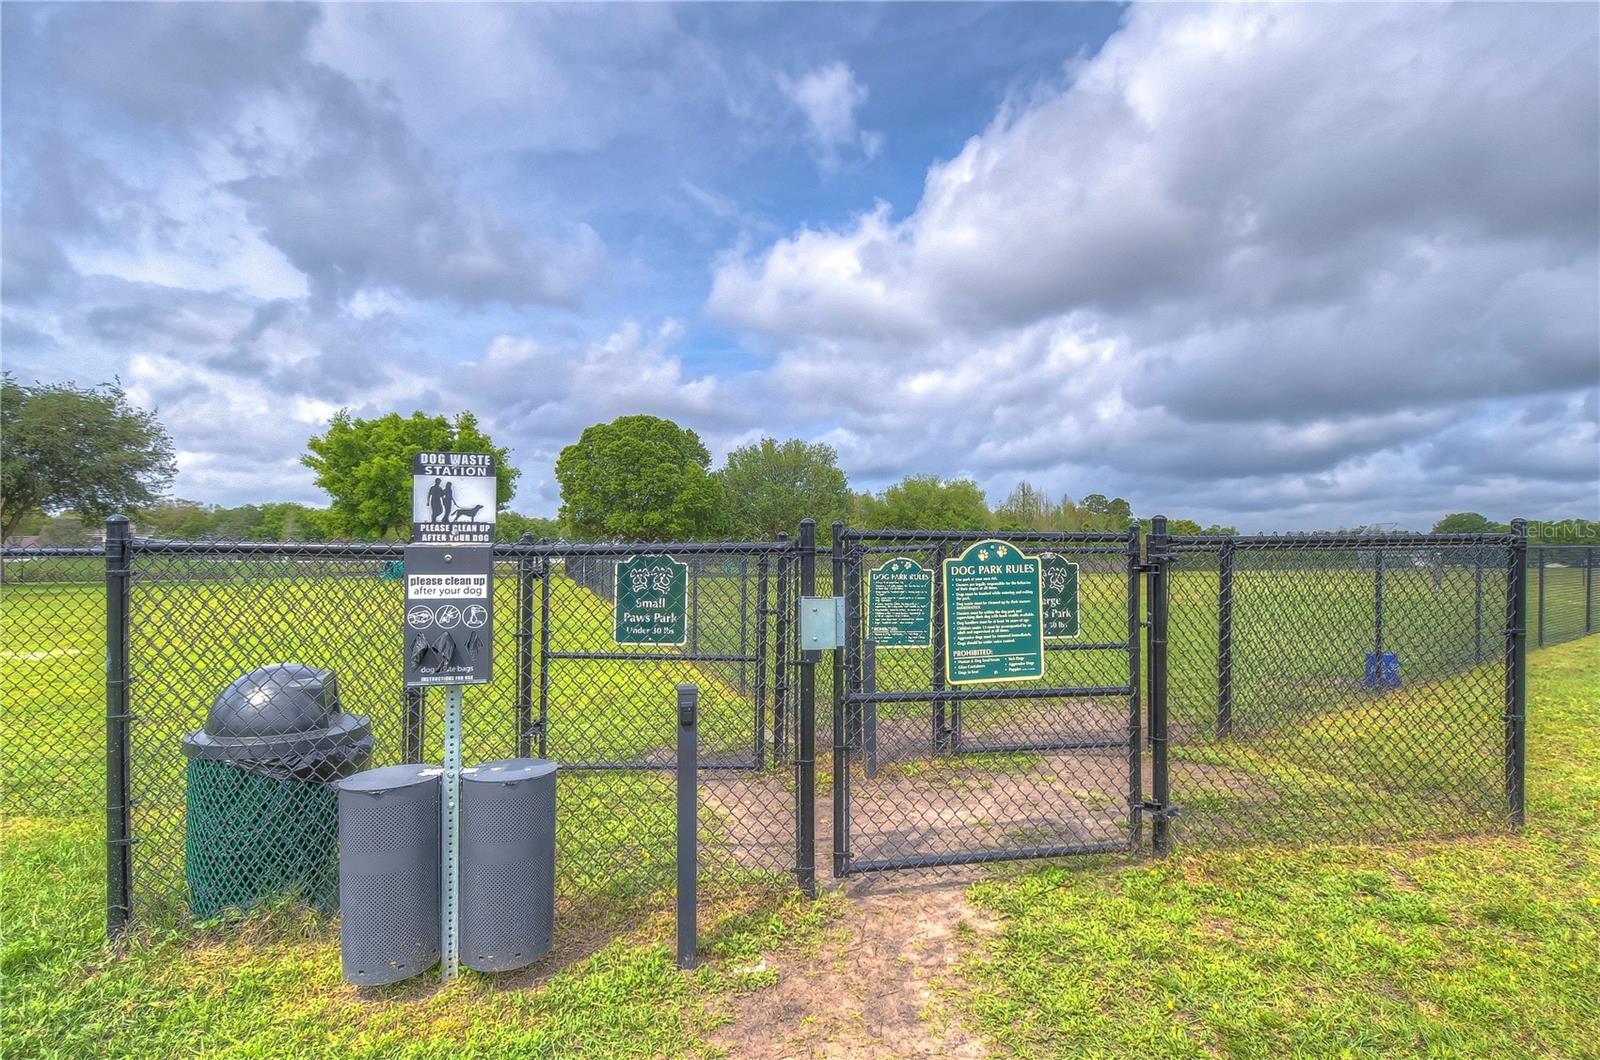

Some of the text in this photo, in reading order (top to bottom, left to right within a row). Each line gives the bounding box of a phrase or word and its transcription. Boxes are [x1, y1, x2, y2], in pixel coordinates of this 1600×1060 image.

[420, 453, 491, 465] DOG WASTE
[425, 466, 486, 476] STATION
[420, 524, 450, 532] PLEASE
[452, 524, 477, 532] CLEAN
[422, 534, 489, 542] AFTER YOUR DOG
[951, 564, 1035, 576] DOG PARK RULES
[410, 576, 485, 586] please clean up
[414, 586, 482, 596] after your dog
[636, 598, 666, 608] Small
[1043, 598, 1061, 608] arge
[623, 612, 677, 622] Paws Park
[1051, 608, 1072, 618] Park
[652, 627, 662, 635] 30
[953, 649, 993, 657] PROHIBITED:
[420, 666, 435, 674] dog
[456, 665, 474, 674] bags
